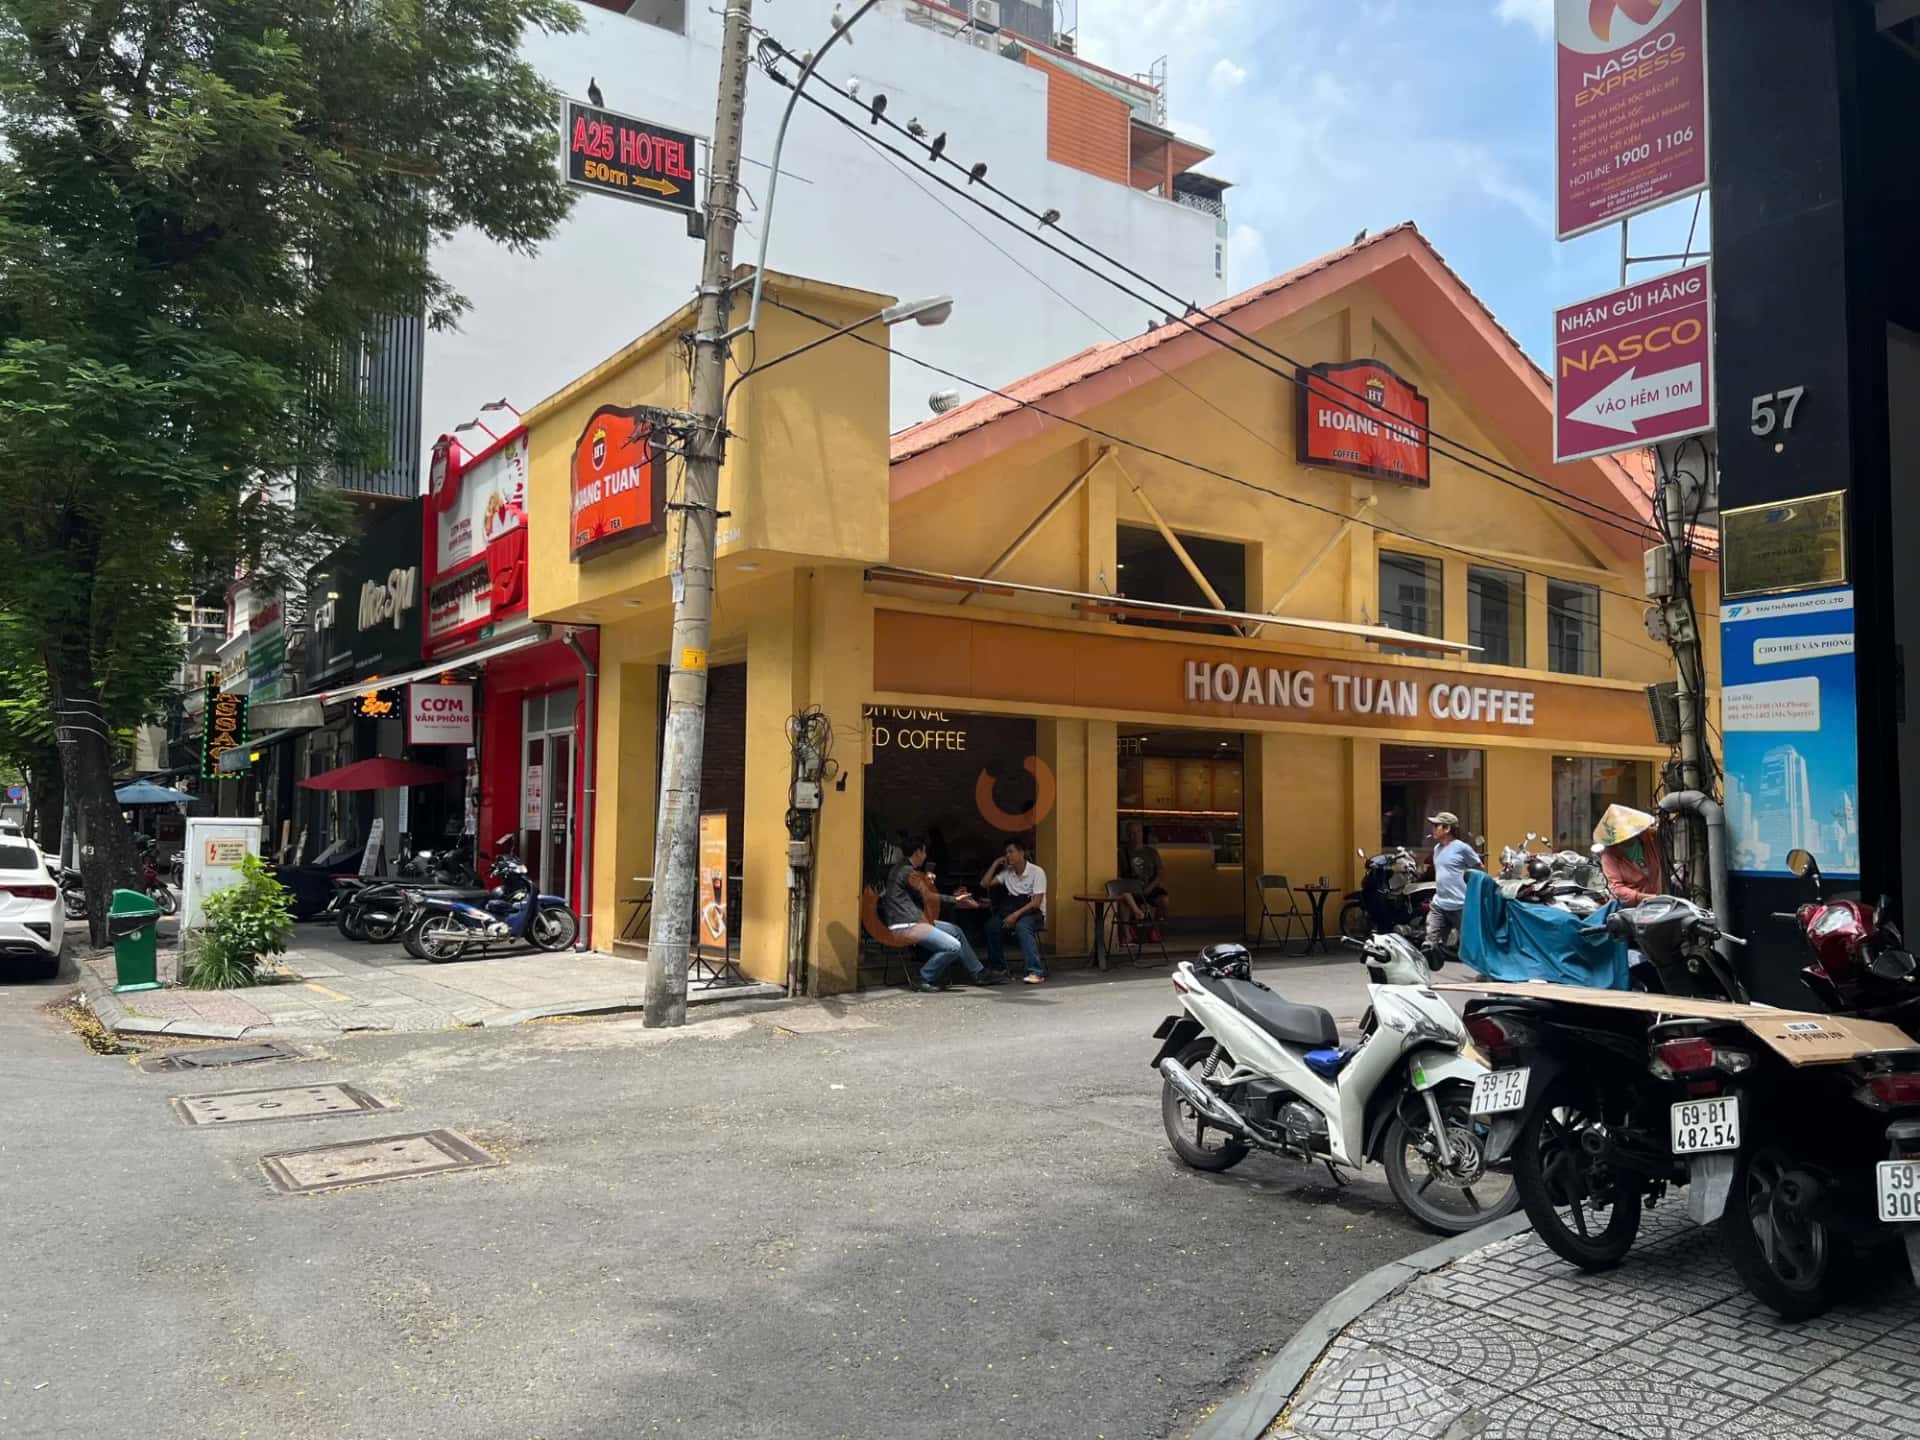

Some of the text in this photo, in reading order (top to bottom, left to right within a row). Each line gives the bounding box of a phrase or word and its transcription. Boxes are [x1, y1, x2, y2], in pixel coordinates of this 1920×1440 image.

[1583, 32, 1677, 87] NASCO
[1575, 46, 1686, 108] EXPRESS
[572, 116, 692, 181] A25 HOTEL
[1569, 162, 1612, 189] HOTLINE
[1614, 144, 1650, 169] 1900
[1656, 126, 1694, 153] 1106
[584, 160, 628, 186] 50m
[1561, 277, 1702, 334] NHẬN GỬI HÀNG
[1562, 318, 1702, 378] NASCO
[1368, 389, 1383, 403] HT
[1595, 396, 1626, 416] VÀO
[1665, 380, 1694, 400] 10M
[1751, 385, 1805, 437] 57
[1318, 409, 1420, 448] HOANG TUAN
[1333, 448, 1360, 460] COFFEE
[603, 466, 640, 497] TUAN
[421, 698, 463, 712] CƠM
[1183, 660, 1536, 726] HOANG TUAN COFFEE
[898, 729, 968, 751] COFFEE
[1482, 1071, 1520, 1092] 59-T2
[1475, 1089, 1521, 1112] 111.50
[1682, 1101, 1726, 1126] 69-B1
[1678, 1123, 1736, 1149] 482.54
